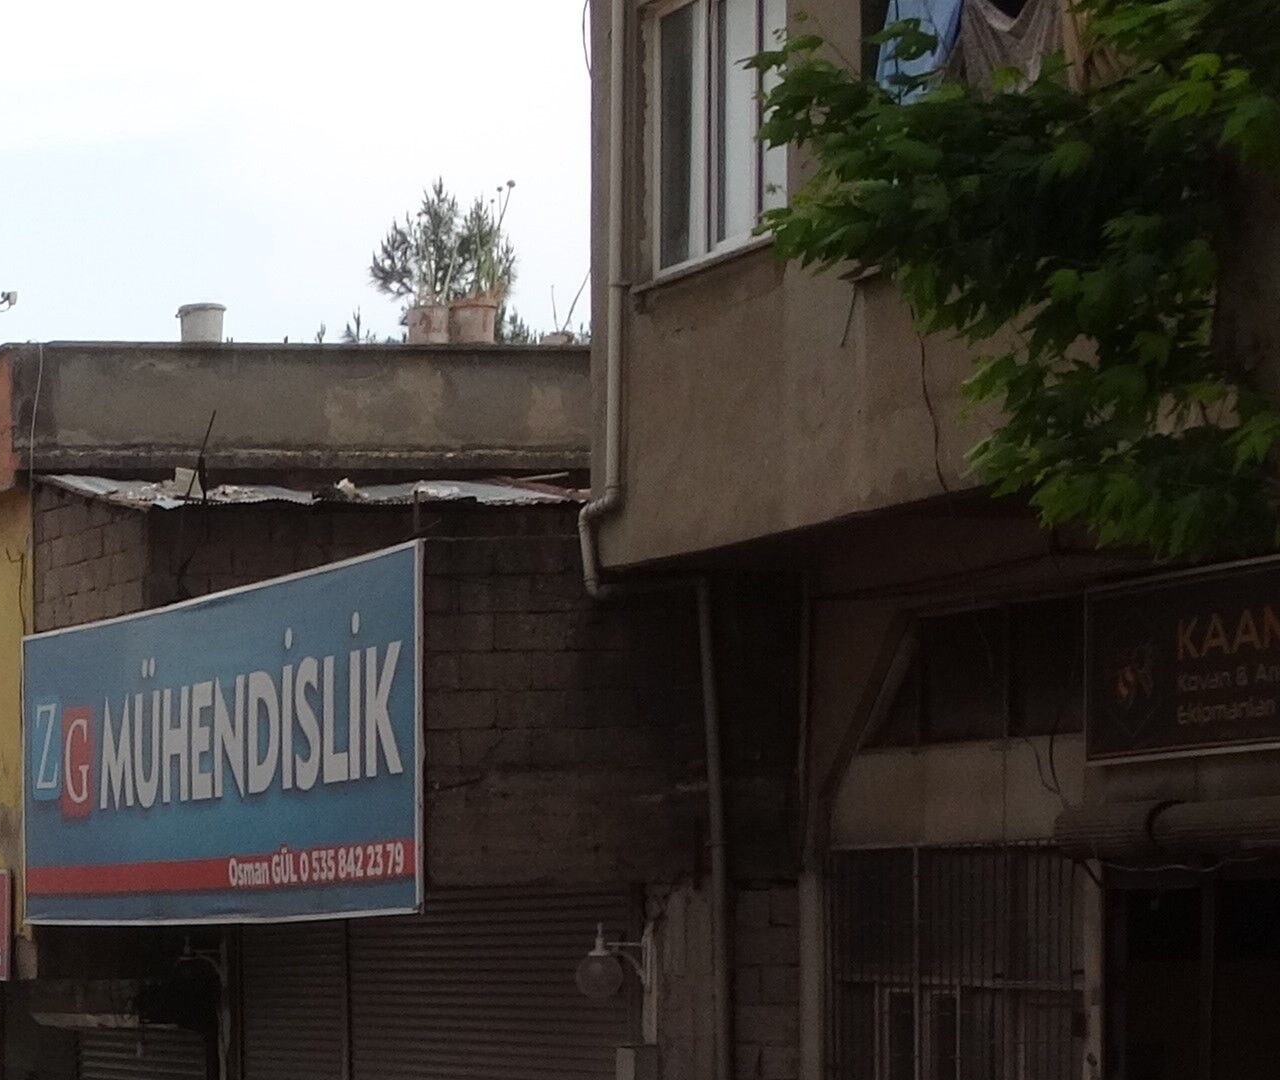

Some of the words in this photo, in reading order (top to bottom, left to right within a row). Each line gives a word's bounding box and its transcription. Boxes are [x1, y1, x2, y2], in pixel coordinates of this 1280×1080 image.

[100, 612, 403, 811] MÜHENDİSLİK
[229, 858, 270, 886] Osman
[272, 847, 298, 884] GÜL
[300, 852, 309, 882] 0
[312, 850, 335, 880] 535
[338, 846, 364, 878] 842
[366, 844, 383, 875] 23
[387, 842, 404, 874] 79
